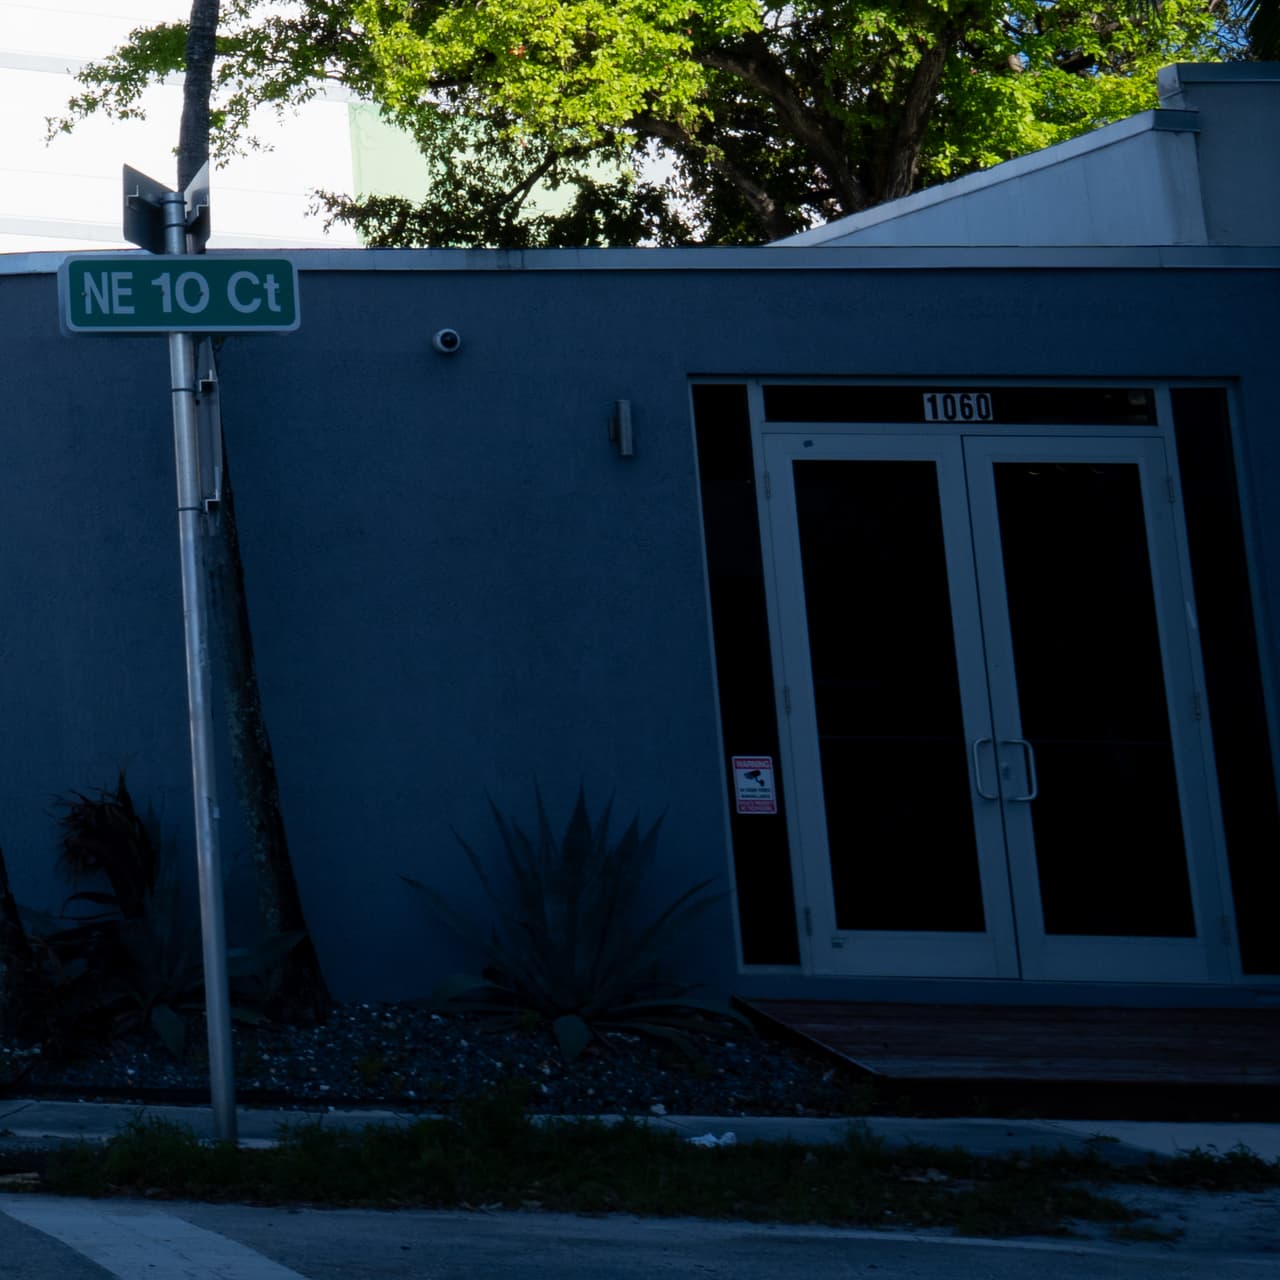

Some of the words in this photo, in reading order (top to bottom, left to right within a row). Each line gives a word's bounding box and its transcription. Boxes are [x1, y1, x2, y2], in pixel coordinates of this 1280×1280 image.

[83, 271, 135, 314] NE
[151, 271, 209, 313] 10
[227, 271, 281, 313] Ct
[926, 393, 991, 419] 1060
